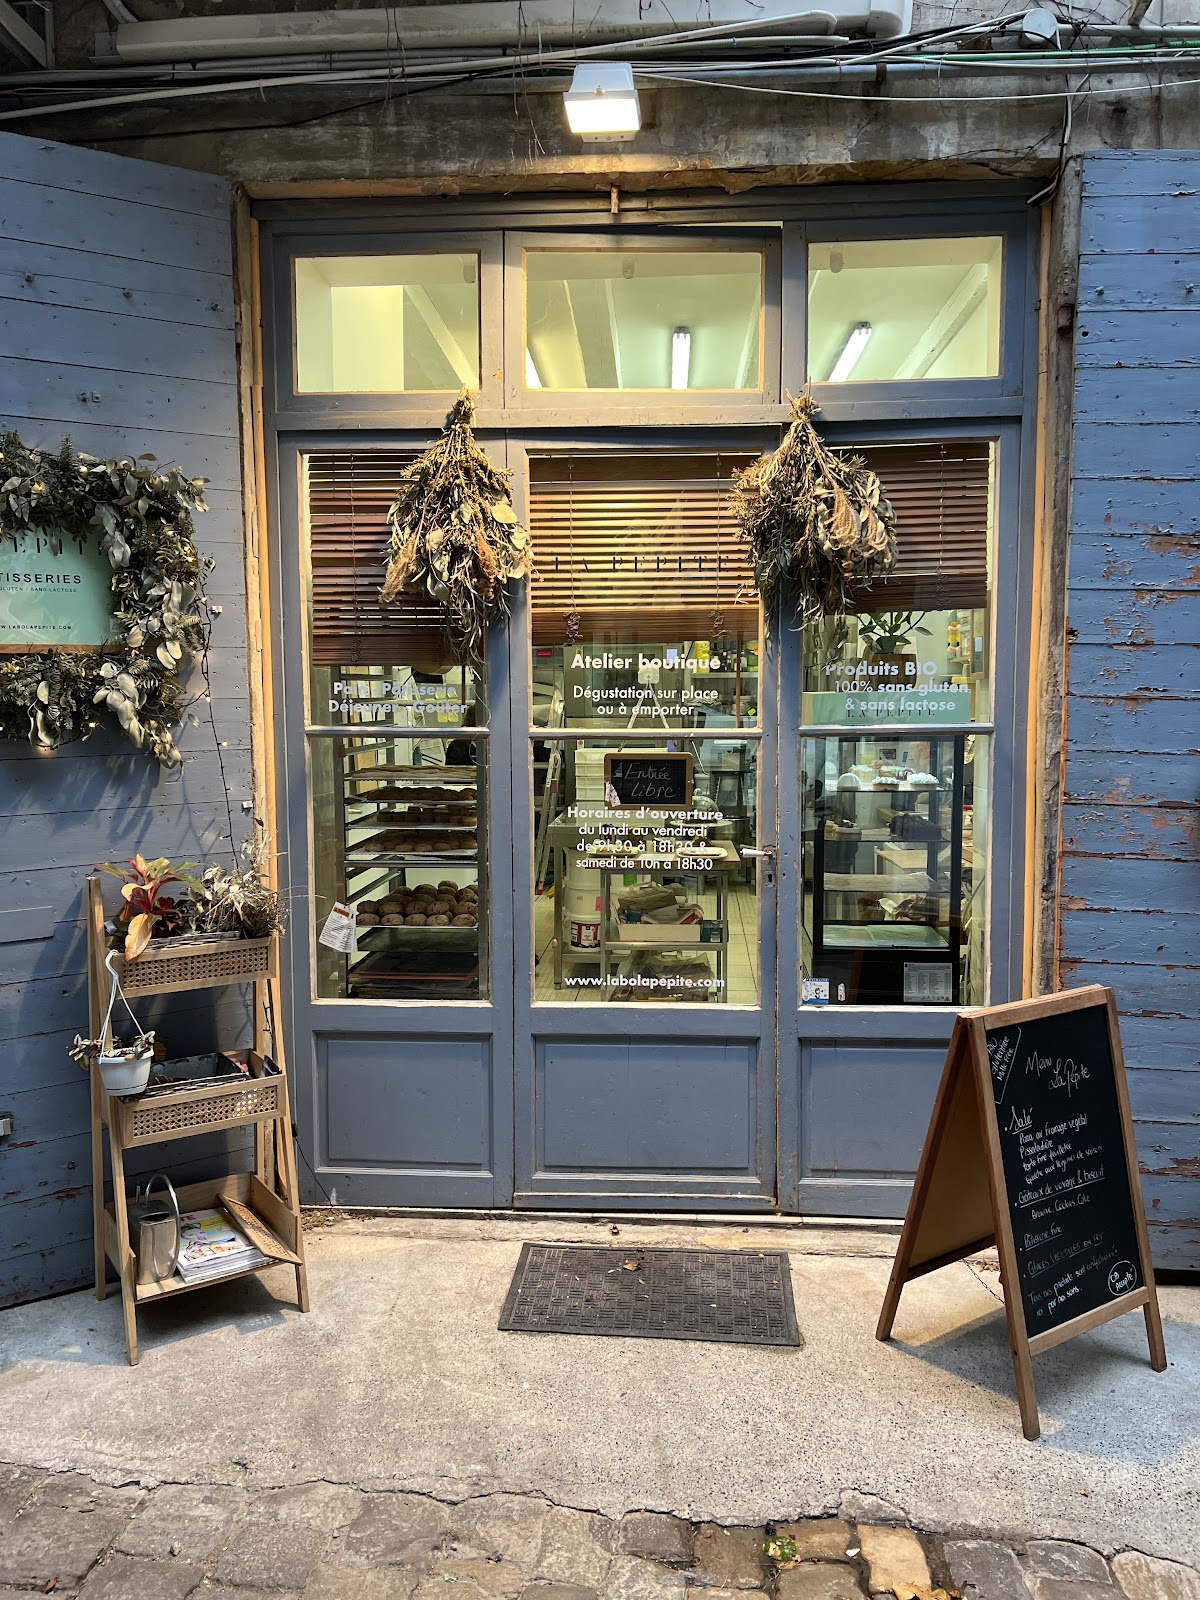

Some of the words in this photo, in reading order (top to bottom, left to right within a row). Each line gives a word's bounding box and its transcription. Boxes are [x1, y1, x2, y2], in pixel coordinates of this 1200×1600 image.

[612, 556, 730, 573] PEPITE
[571, 653, 633, 669] Atelier
[638, 653, 721, 674] boutique
[825, 660, 899, 676] Produits
[904, 661, 937, 676] BIO
[573, 685, 653, 702] Dégustation
[657, 689, 676, 700] sur
[681, 685, 719, 702] place
[834, 680, 873, 693] 100%
[877, 683, 914, 693] sans
[918, 678, 969, 697] gluten
[328, 700, 399, 716] Déjeuner
[412, 701, 468, 714] Goûter
[597, 705, 614, 715] ou
[618, 702, 627, 715] à
[631, 704, 695, 718] emporter
[844, 697, 855, 711] &
[860, 699, 895, 711] sans
[900, 697, 956, 711] lactose
[624, 763, 672, 781] Entrée
[567, 806, 631, 819] Horaires
[635, 807, 724, 821] d'ouverture
[578, 822, 595, 835] du
[598, 823, 630, 836] lundi
[632, 826, 649, 836] au
[652, 824, 708, 838] vendredi
[576, 839, 592, 852] de
[599, 840, 633, 853] 9h30
[637, 840, 646, 852] à
[652, 840, 693, 853] 18h30
[575, 857, 617, 868] samedi
[619, 856, 635, 868] de
[640, 858, 661, 869] 10h
[676, 857, 713, 870] 18h30
[564, 974, 725, 988] www.labolapepite.com
[1009, 1105, 1033, 1131] Salé
